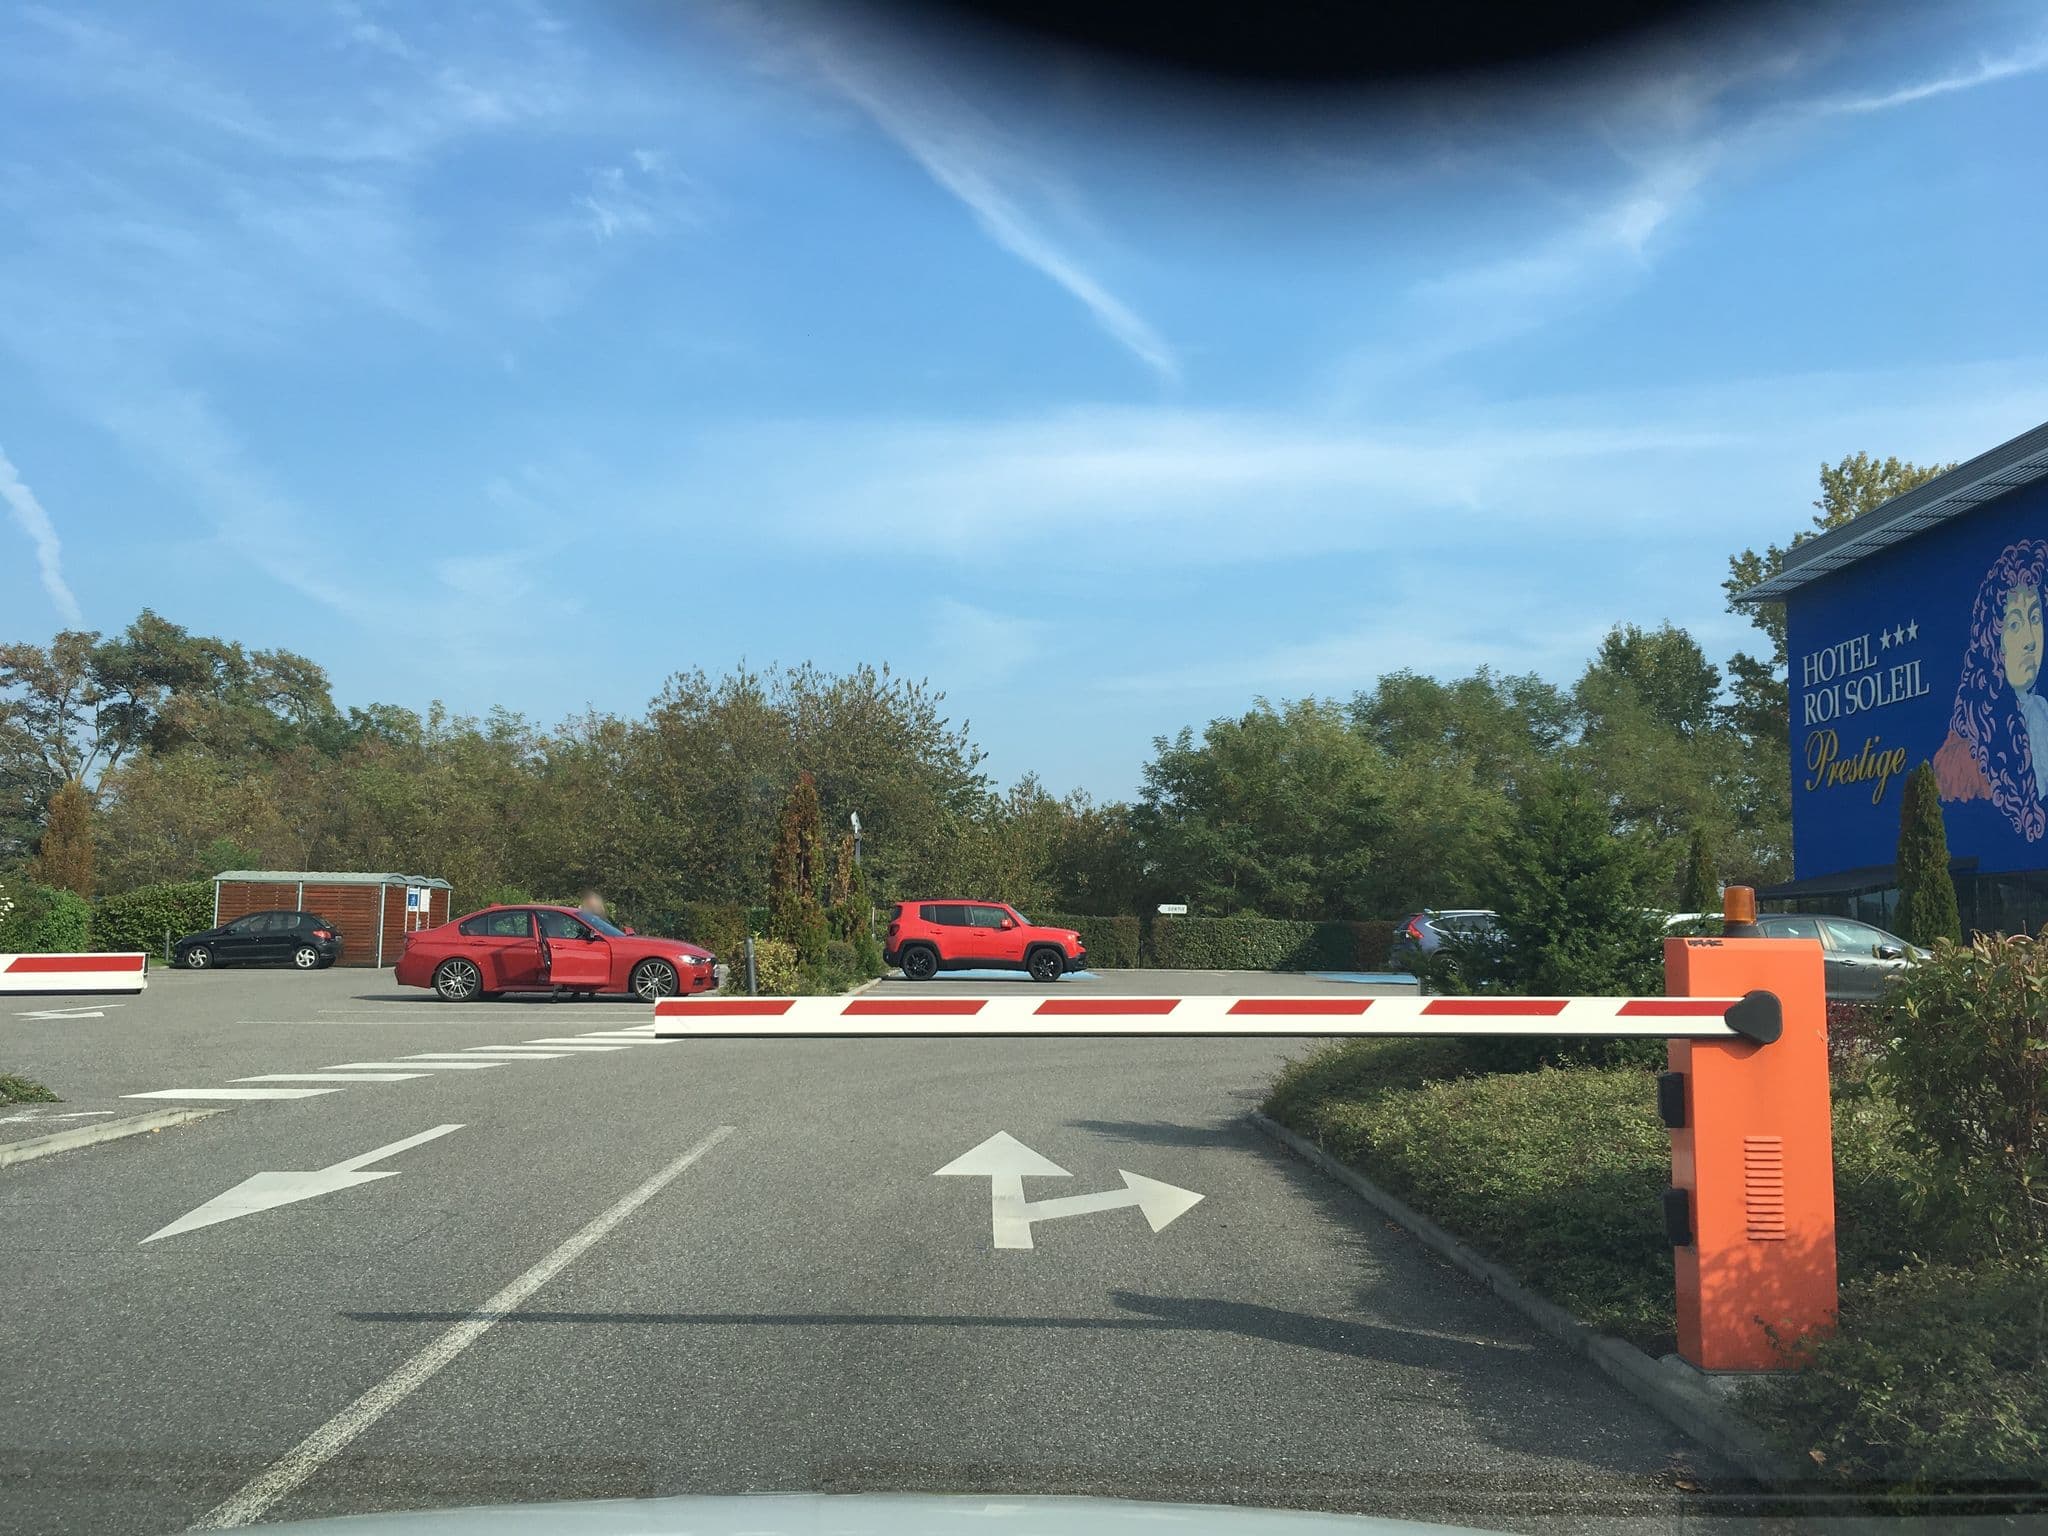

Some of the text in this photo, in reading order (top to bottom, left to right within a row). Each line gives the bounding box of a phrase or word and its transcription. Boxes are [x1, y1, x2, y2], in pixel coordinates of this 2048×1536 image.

[1802, 634, 1878, 688] HOTEL
[1803, 660, 1930, 726] ROI SOLEIL
[1804, 729, 1906, 805] Prestige
